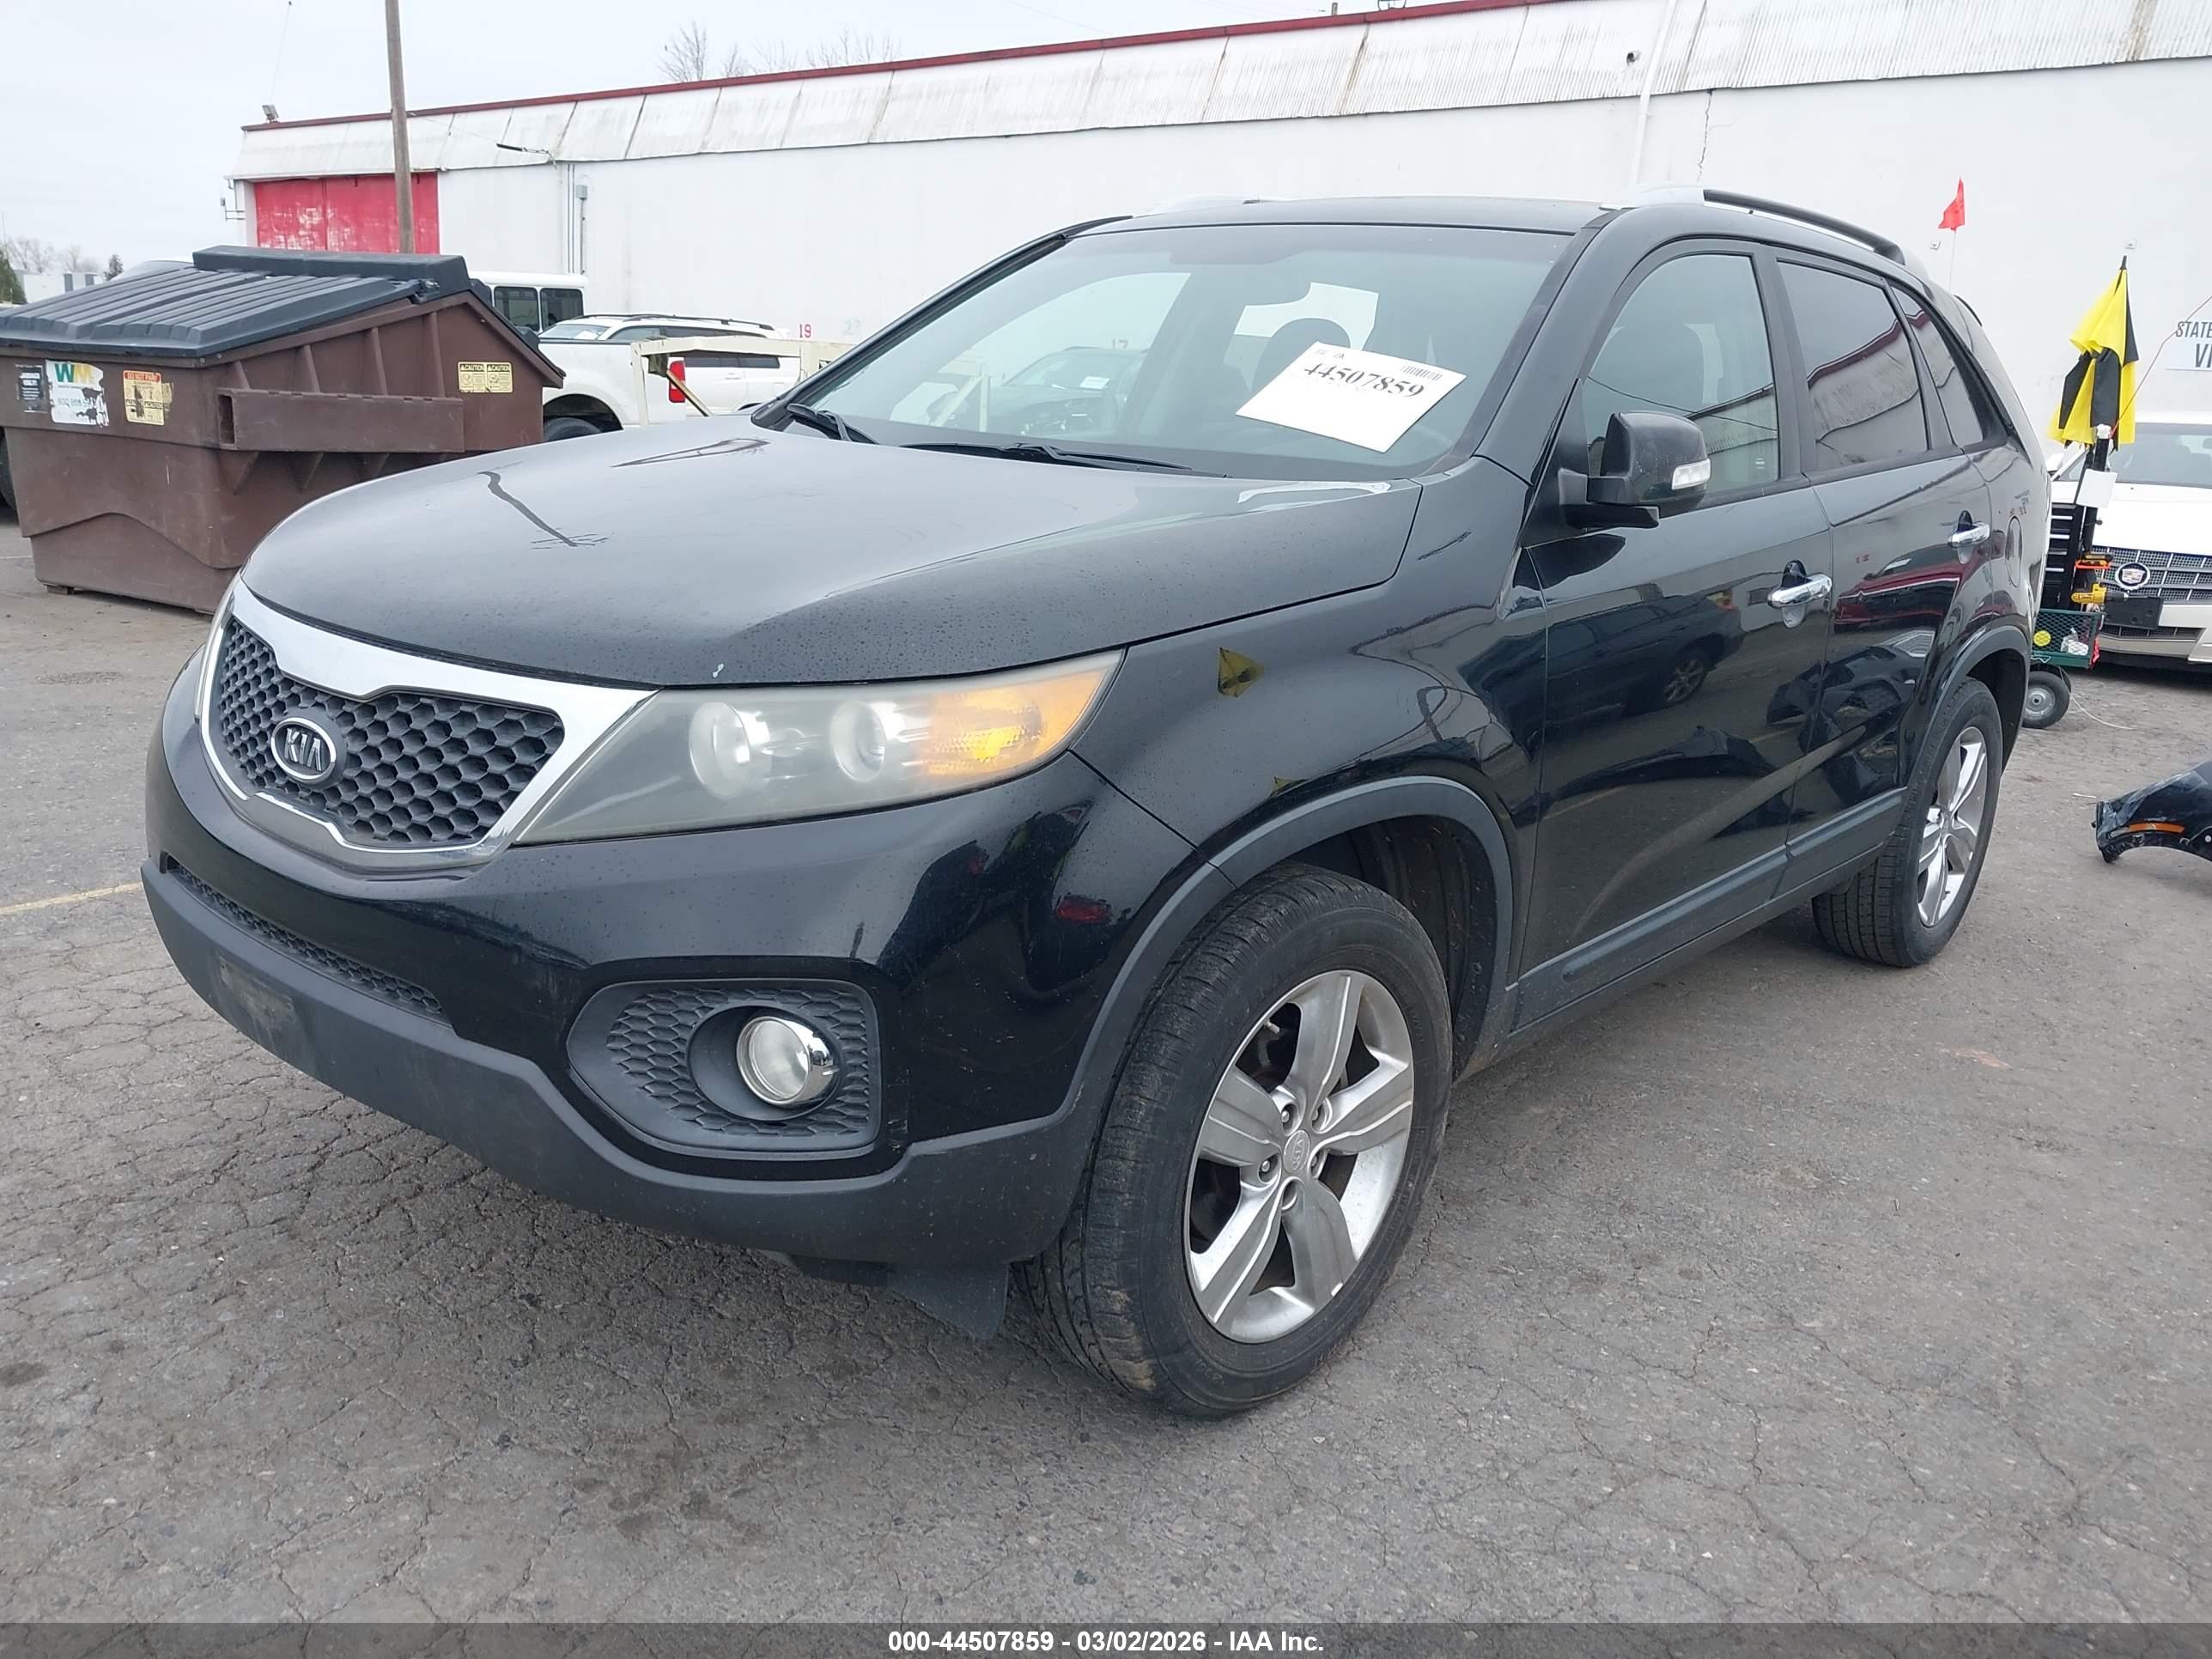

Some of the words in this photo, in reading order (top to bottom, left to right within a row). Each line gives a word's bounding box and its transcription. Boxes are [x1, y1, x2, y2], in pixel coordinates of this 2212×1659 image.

[799, 324, 811, 338] 19
[1304, 362, 1425, 398] 44507859
[284, 727, 323, 772] KIA
